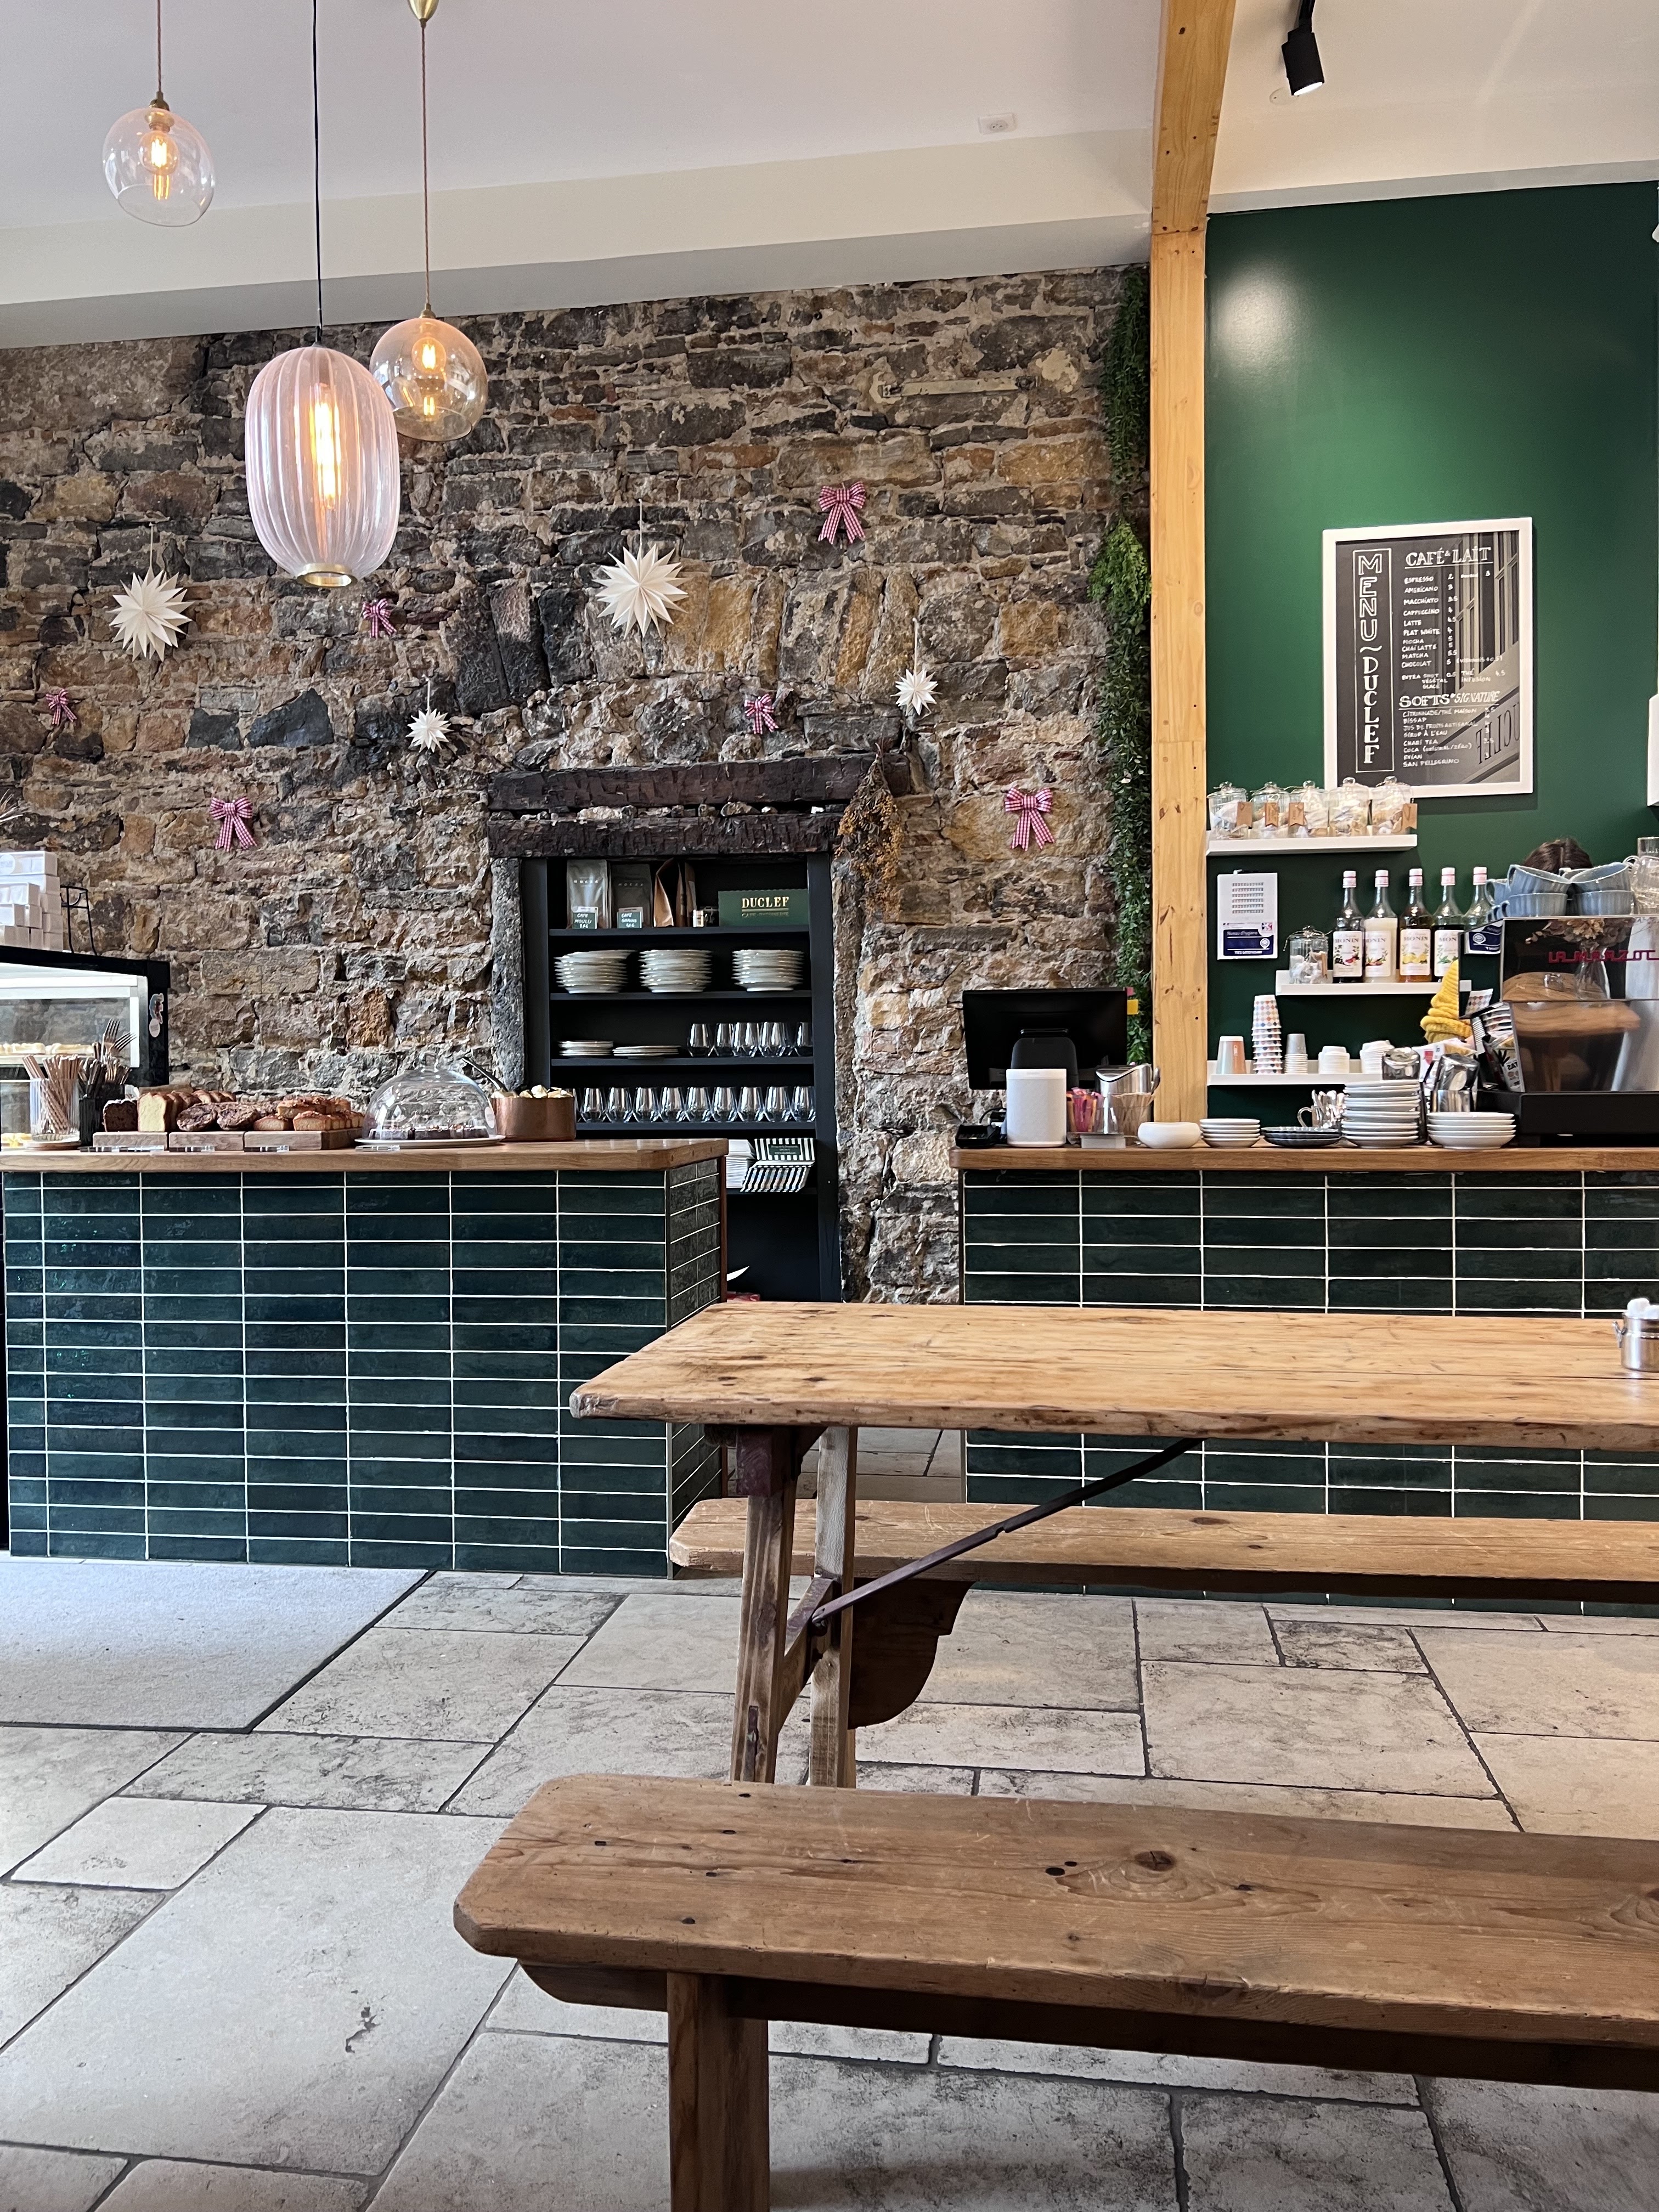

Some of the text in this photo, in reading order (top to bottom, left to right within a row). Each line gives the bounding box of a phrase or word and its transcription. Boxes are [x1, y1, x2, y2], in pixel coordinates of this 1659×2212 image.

[1406, 547, 1445, 566] CAFÉ
[1404, 576, 1434, 584] ESPRESSO
[1358, 553, 1383, 641] MENU
[1403, 596, 1439, 606] MACCHIATO
[1401, 660, 1432, 668] CHOCOLAT
[1399, 694, 1450, 708] SOFTS
[1454, 691, 1500, 703] SIGNATURE
[1363, 656, 1380, 764] DUCLEF
[741, 896, 789, 909] DUCLEF
